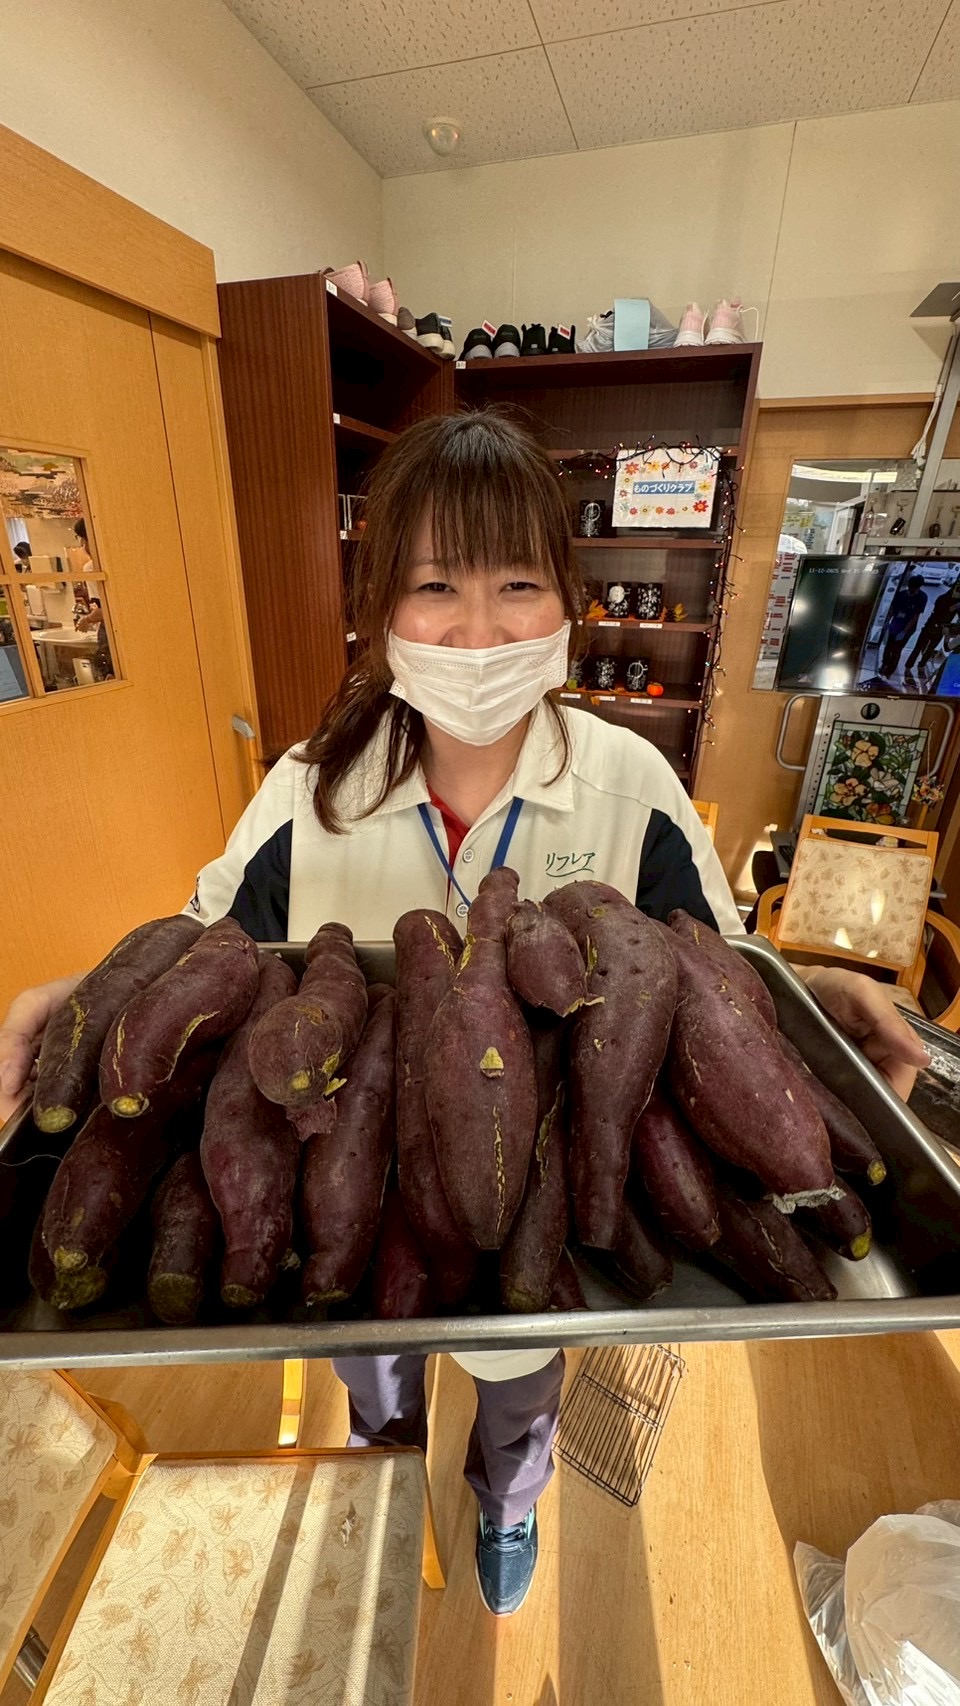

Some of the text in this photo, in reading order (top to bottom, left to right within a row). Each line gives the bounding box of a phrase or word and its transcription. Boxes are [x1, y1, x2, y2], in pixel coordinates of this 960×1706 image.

[634, 482, 693, 493] ものづくりクラブ
[545, 852, 596, 871] リフレア
